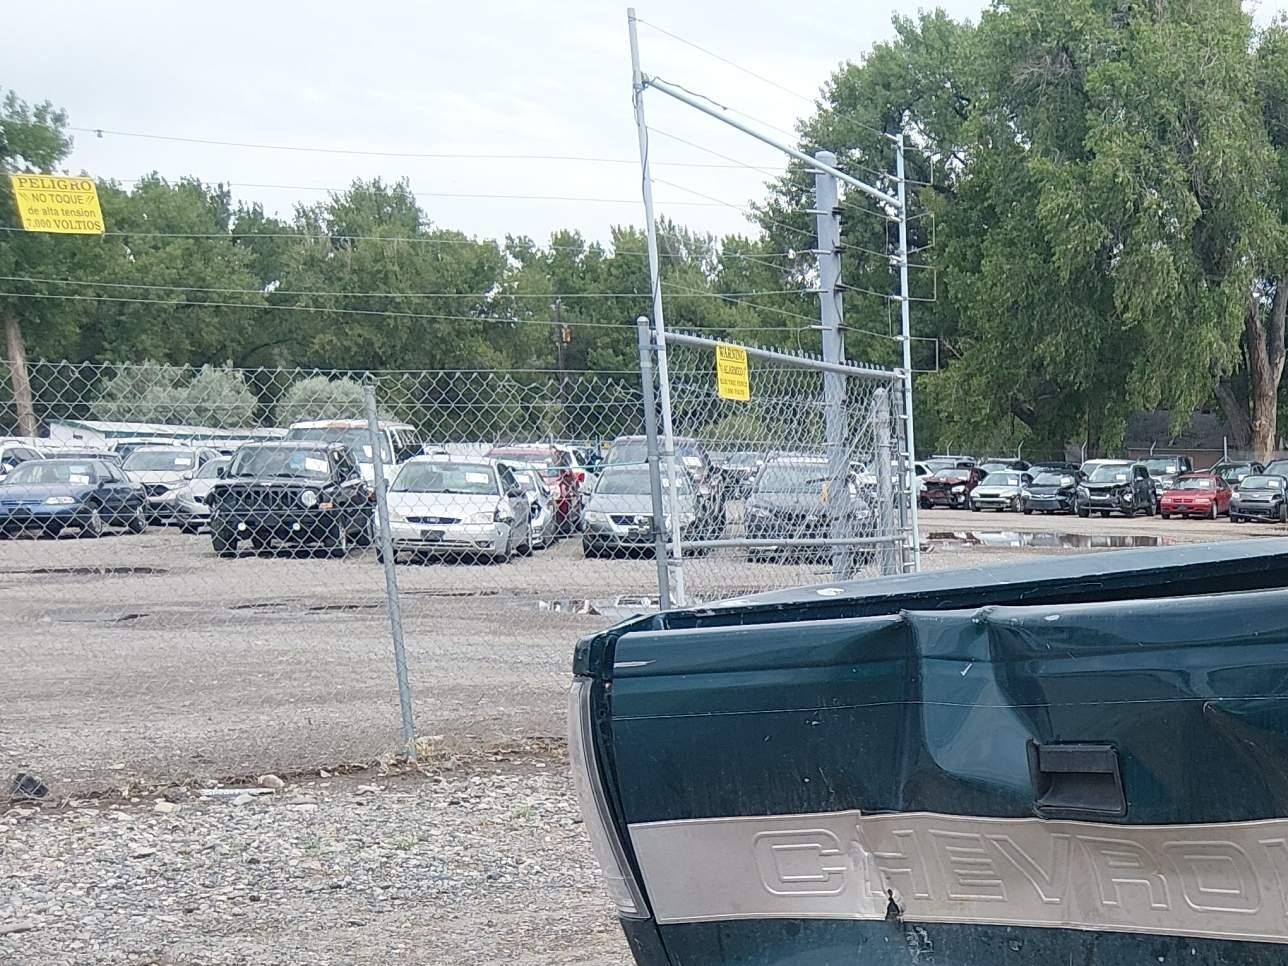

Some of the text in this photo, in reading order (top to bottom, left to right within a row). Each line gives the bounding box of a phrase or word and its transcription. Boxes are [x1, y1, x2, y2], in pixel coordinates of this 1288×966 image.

[17, 177, 92, 191] PELIGRO
[31, 193, 84, 204] NO TOQUE
[28, 206, 97, 217] de alta tension
[54, 220, 101, 231] VOLTIOS
[719, 346, 745, 361] WARNING
